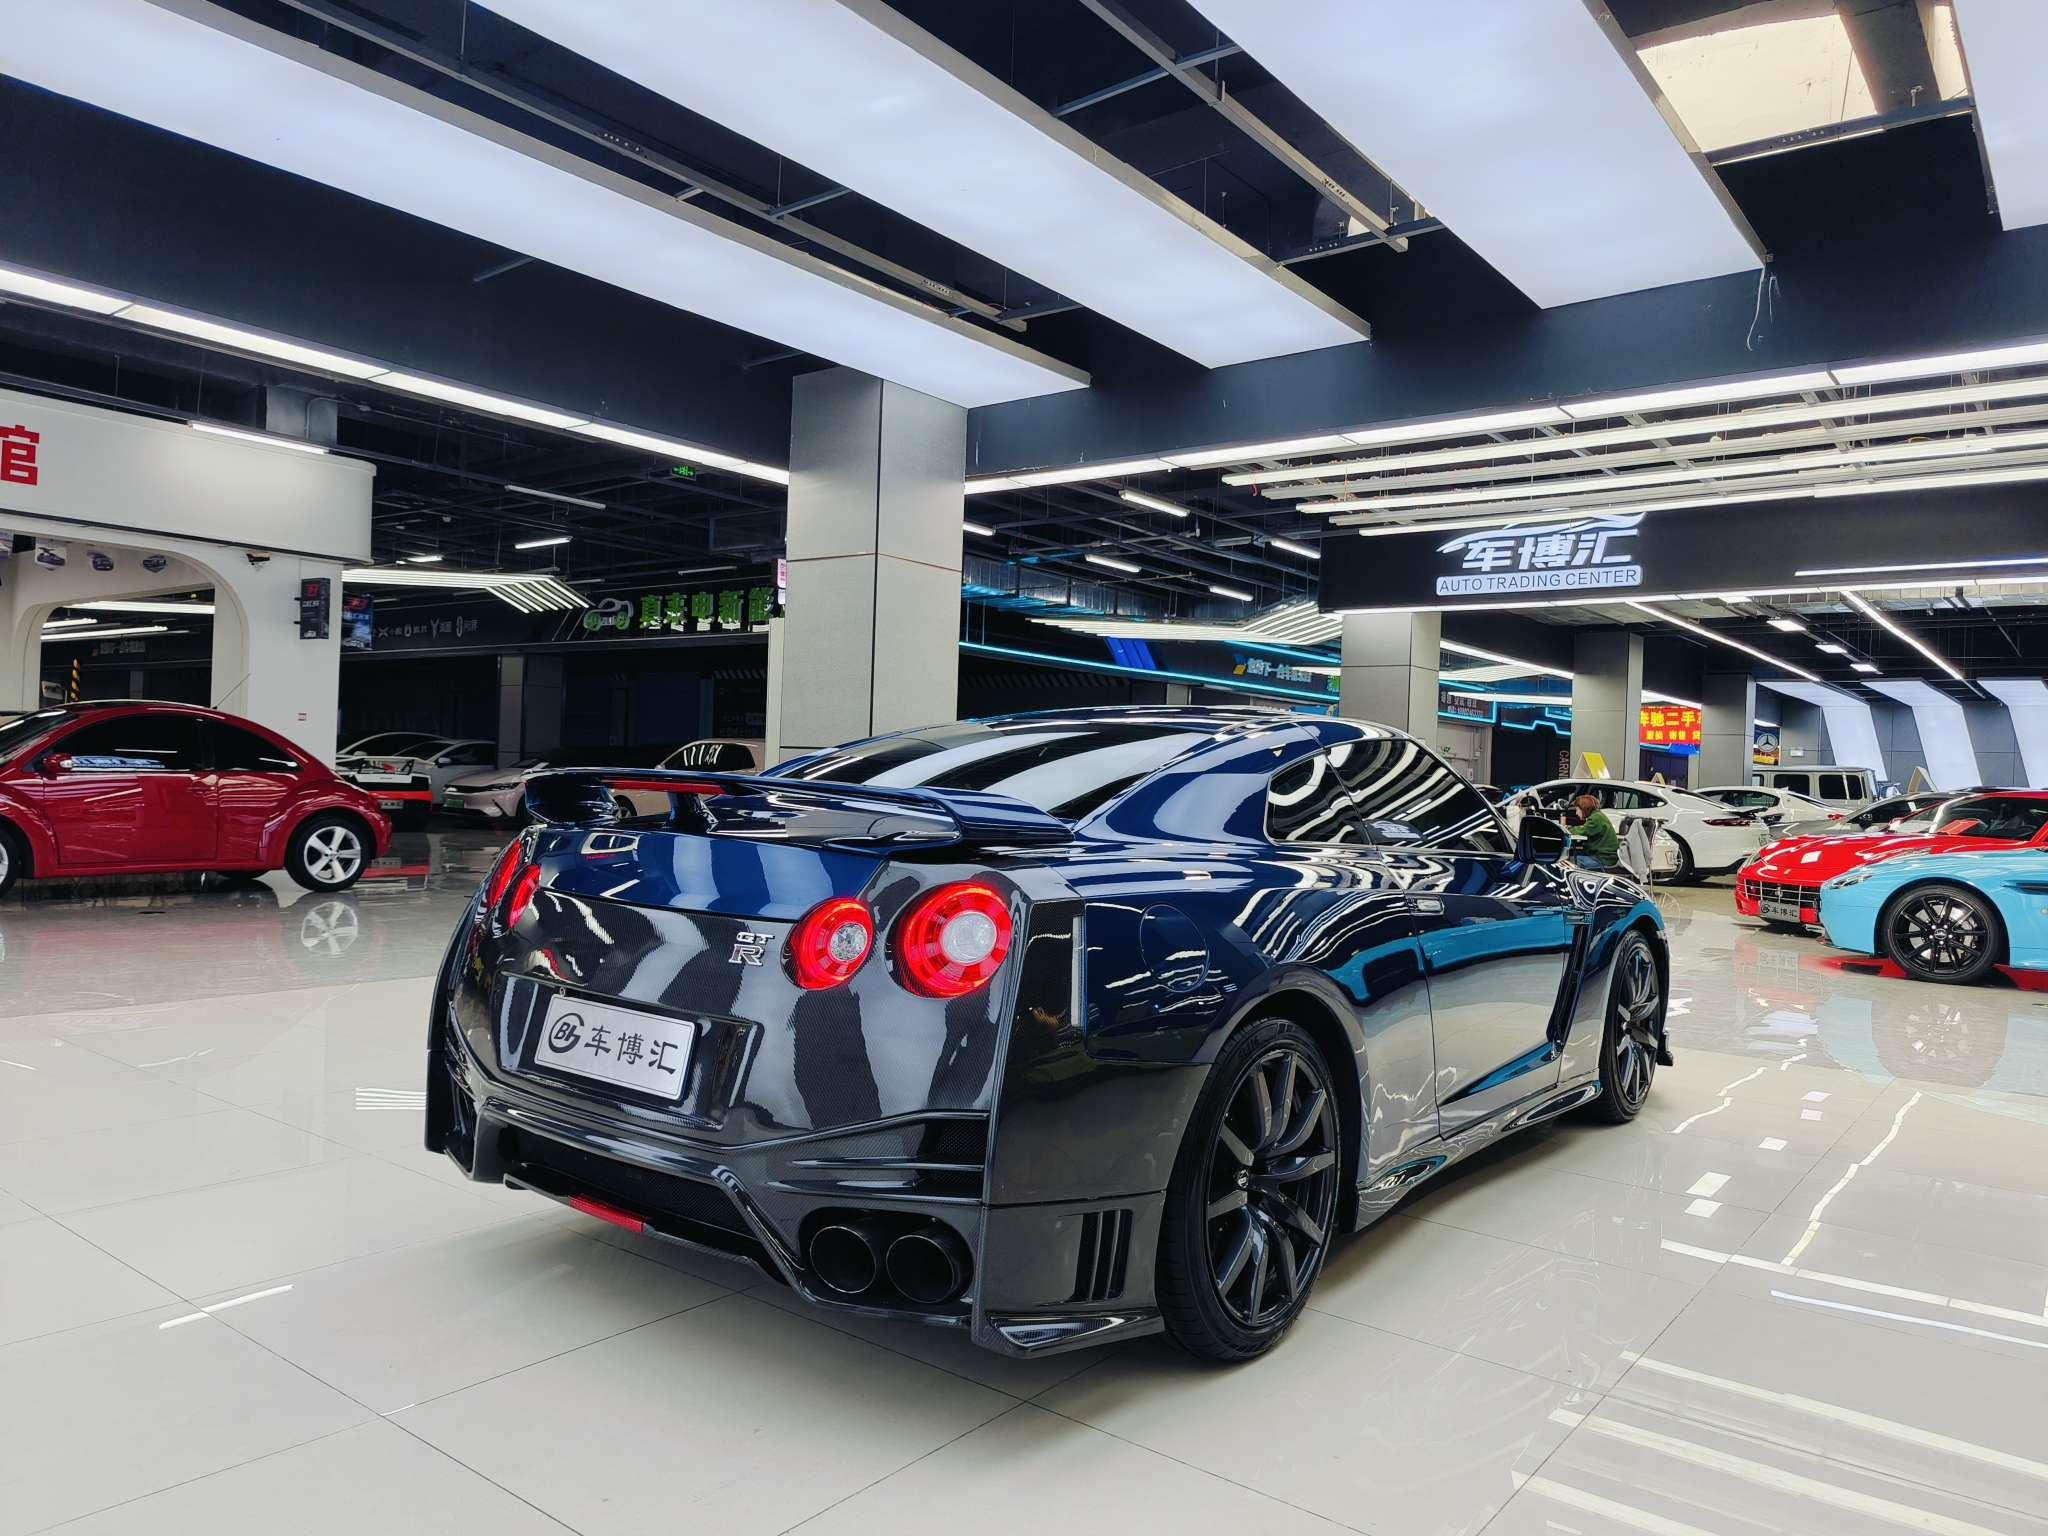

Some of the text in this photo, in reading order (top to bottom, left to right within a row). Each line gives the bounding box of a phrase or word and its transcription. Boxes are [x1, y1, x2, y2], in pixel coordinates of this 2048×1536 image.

[1462, 528, 1639, 572] 车博汇
[1439, 569, 1637, 594] AUTO TRADING CENTER
[1640, 710, 1701, 728] 奔驰二手
[736, 930, 775, 945] GT
[728, 944, 764, 967] R
[584, 1024, 679, 1076] 车博汇
